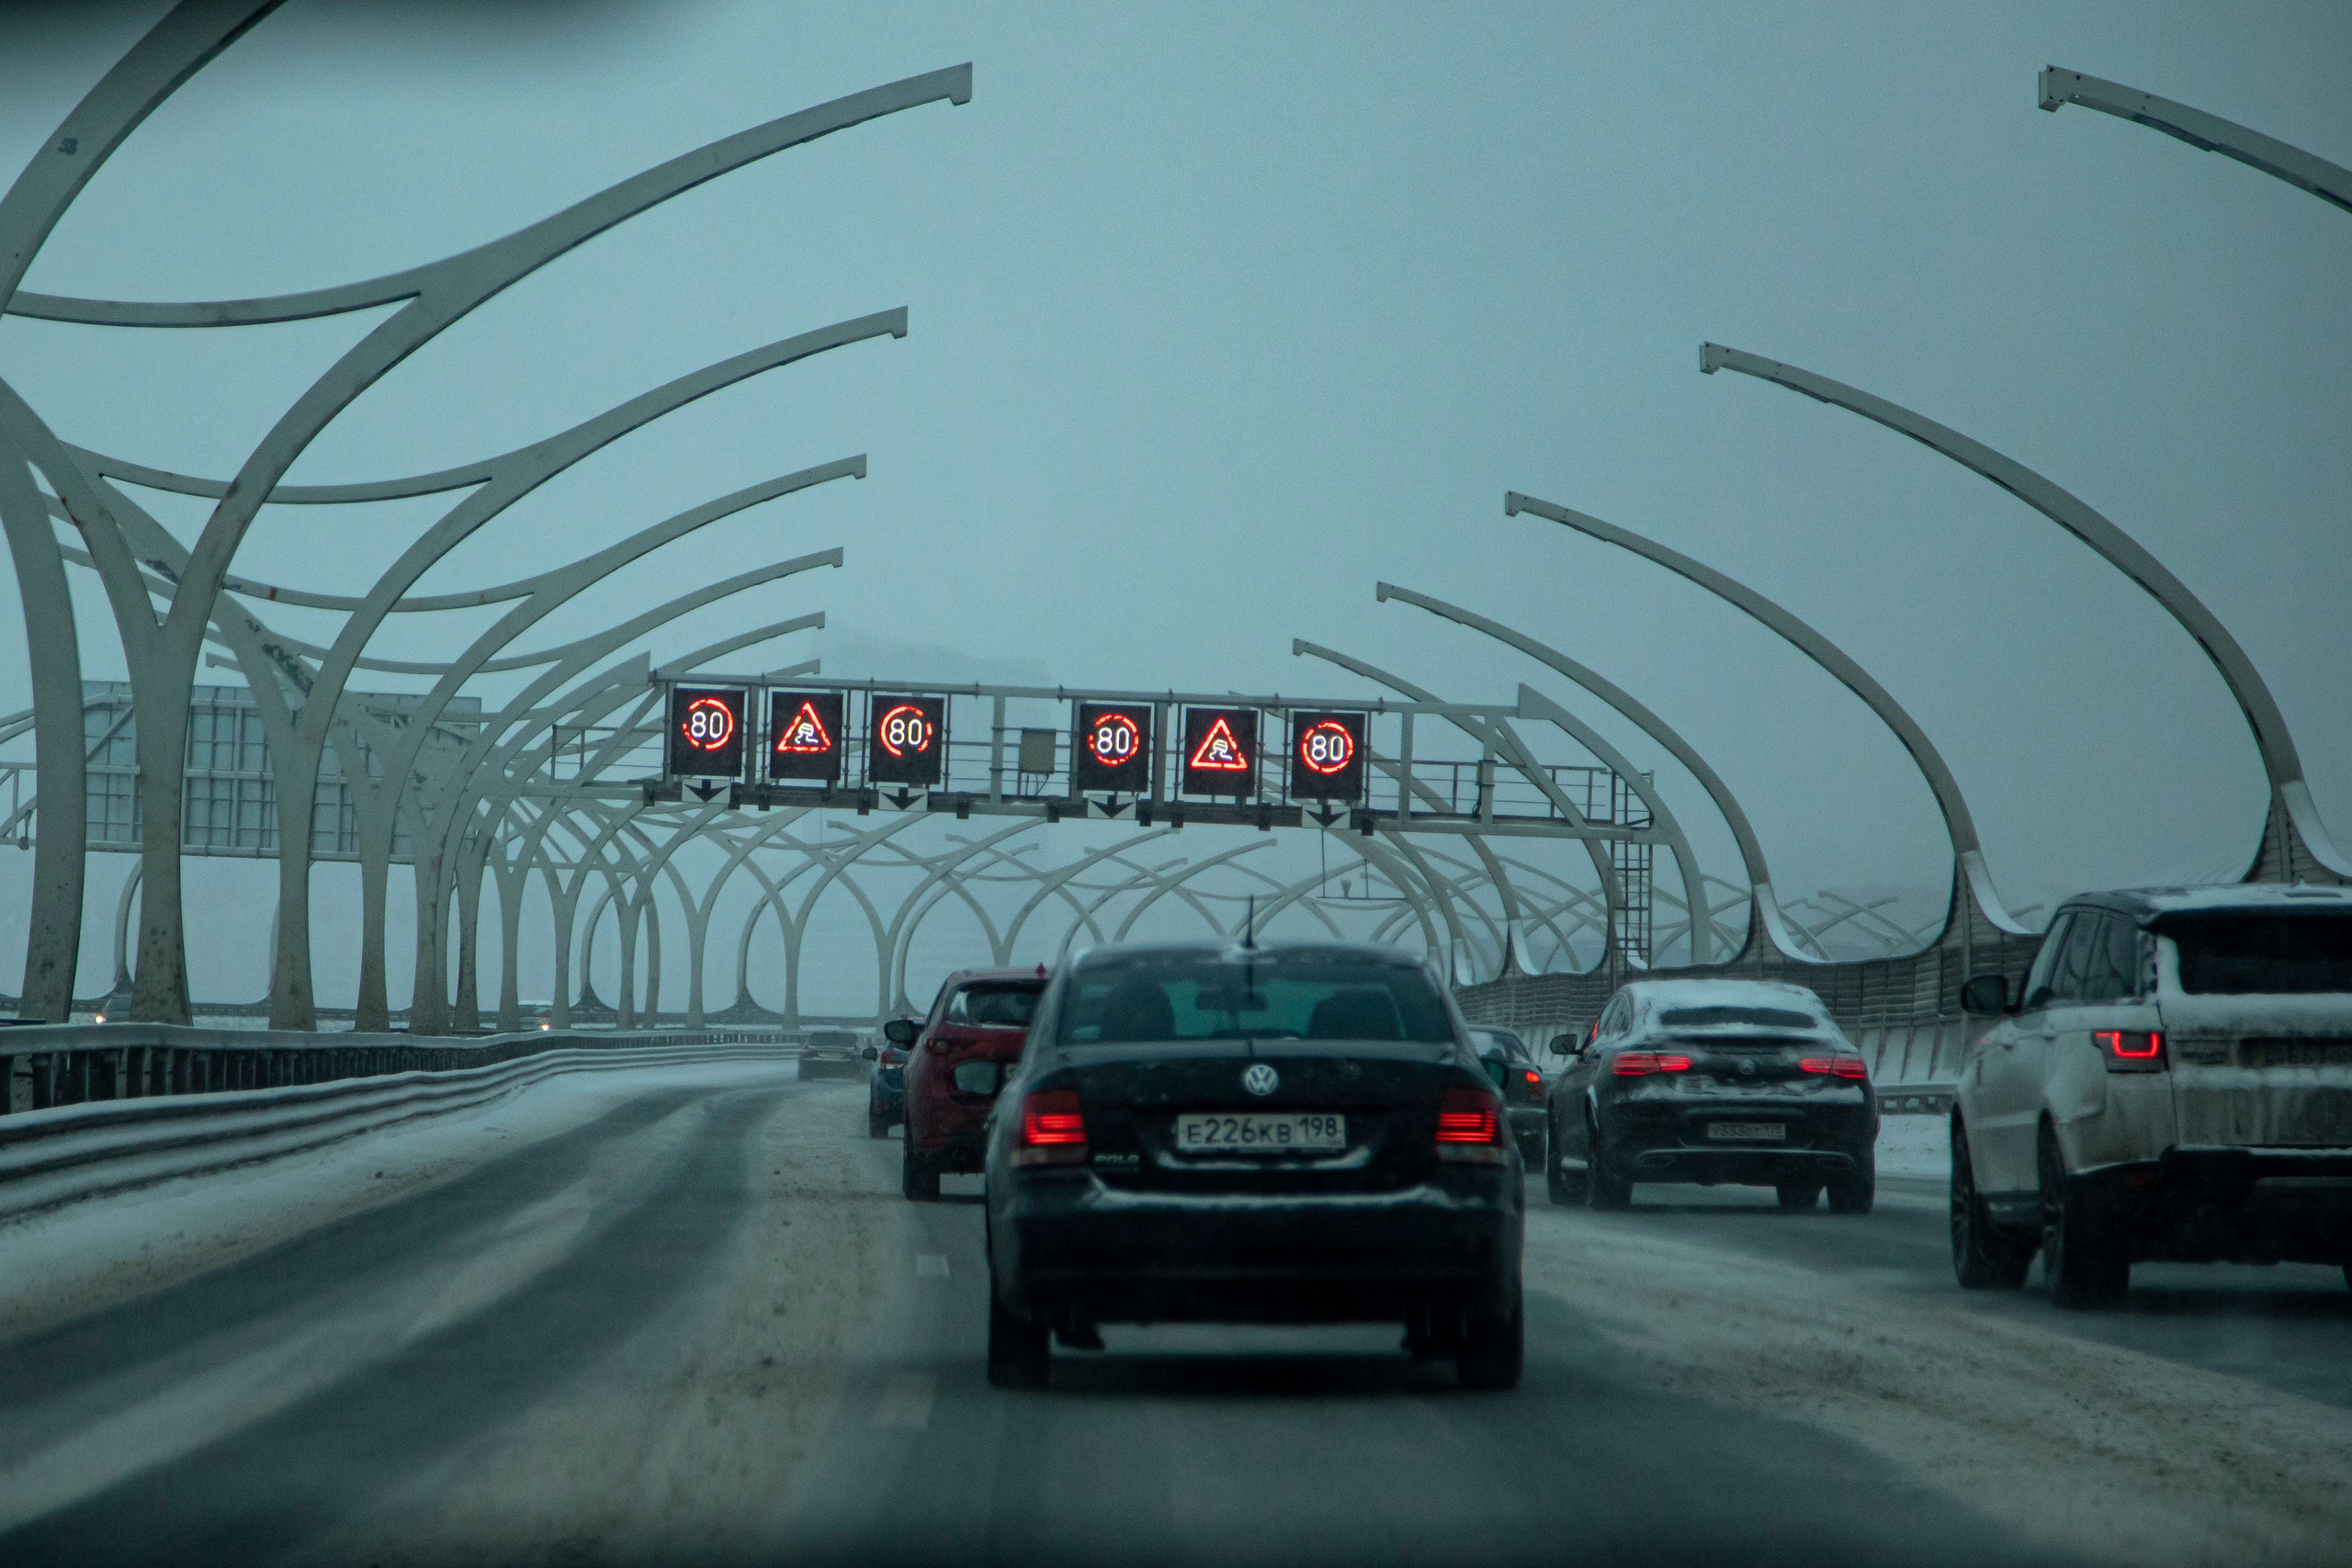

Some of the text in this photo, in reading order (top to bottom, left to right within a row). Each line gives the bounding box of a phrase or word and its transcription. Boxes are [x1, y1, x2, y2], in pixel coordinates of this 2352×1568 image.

[691, 711, 724, 739] 80
[889, 718, 922, 745] 80
[1097, 727, 1130, 754] 80
[1311, 735, 1344, 761] 80
